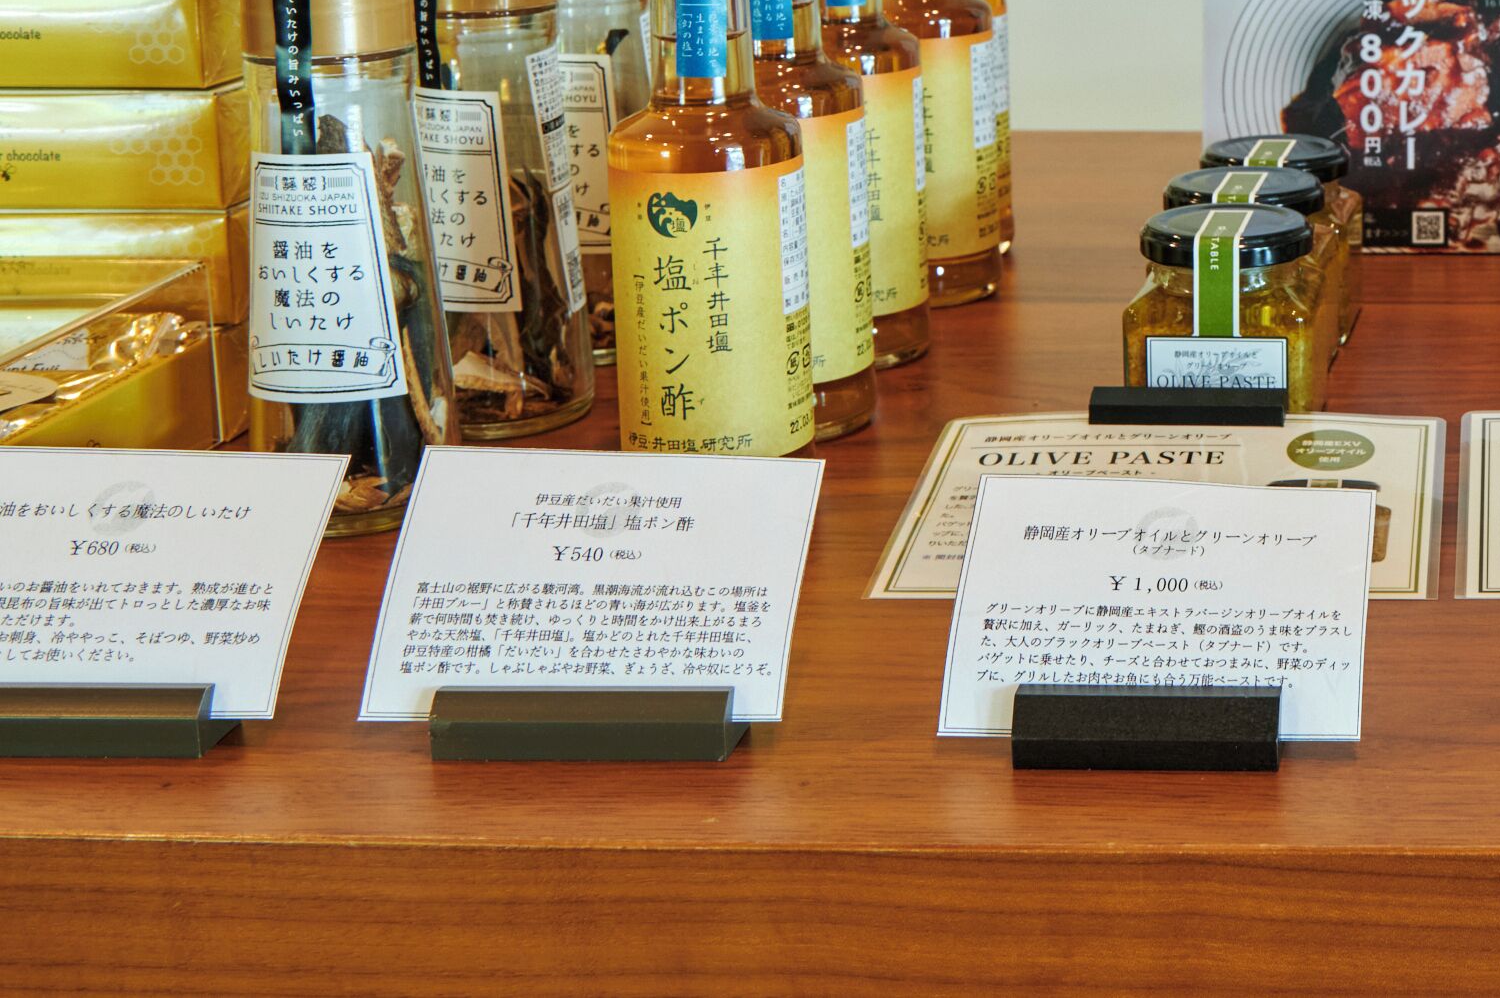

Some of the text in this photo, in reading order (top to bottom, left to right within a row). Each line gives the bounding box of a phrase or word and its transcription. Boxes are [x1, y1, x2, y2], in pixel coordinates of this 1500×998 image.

[272, 193, 317, 202] SHIZUOKA
[320, 192, 355, 202] JAPAN
[258, 202, 357, 216] SHIITAKE SHOYU
[273, 240, 338, 260] 醤油を
[259, 264, 365, 284] おいしくする
[274, 288, 340, 308] 魔法の
[270, 312, 354, 331] しいたけ
[653, 254, 696, 421] 塩ポン酢
[259, 348, 369, 368] しいたけ醤油
[1157, 374, 1276, 389] OLIVE PASTE
[979, 450, 1225, 466] OLIVE PASTE
[535, 493, 682, 510] 伊豆産だいだい果汁使用
[510, 512, 695, 532] 「千年井田塩」塩ポン酢
[1023, 525, 1317, 547] 静岡産オリーブオイルとグリーンオリーブ
[70, 540, 120, 556] ¥680
[551, 545, 604, 562] ¥540
